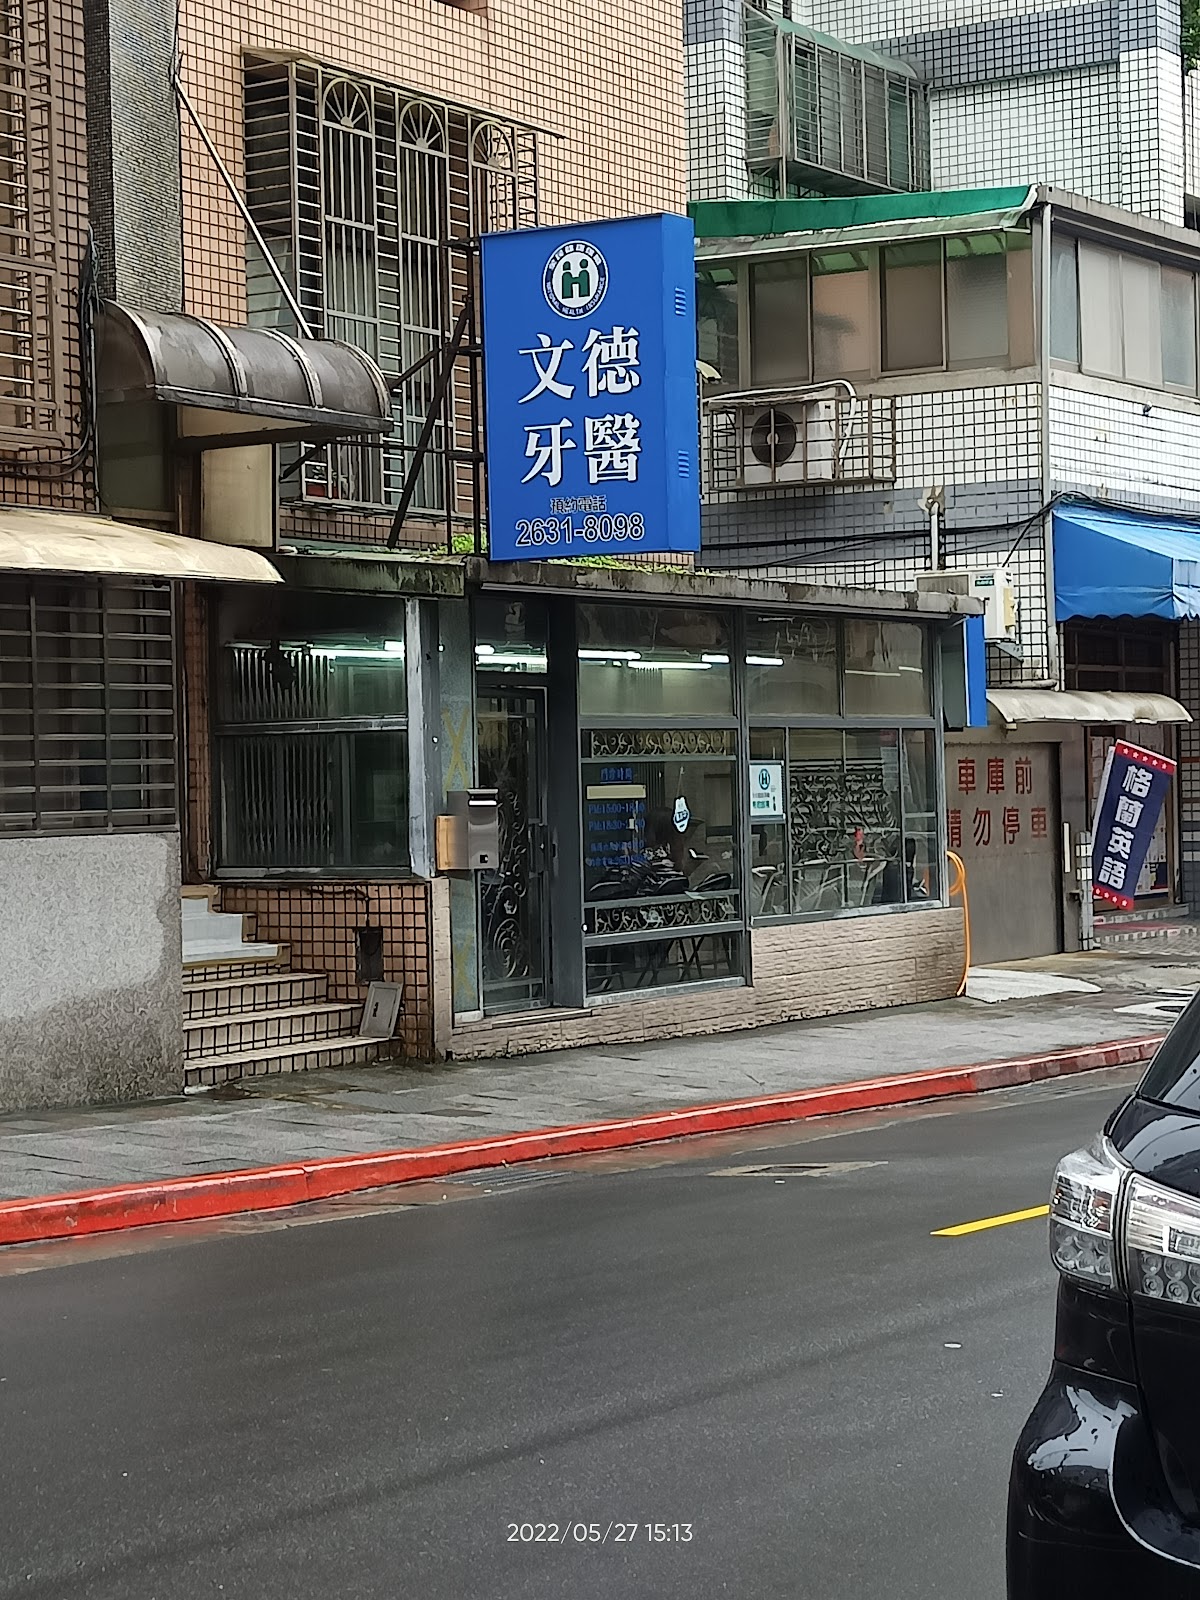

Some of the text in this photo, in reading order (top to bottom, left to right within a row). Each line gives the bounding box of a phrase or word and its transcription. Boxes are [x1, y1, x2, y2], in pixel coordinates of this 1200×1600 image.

[518, 326, 640, 404] 文德
[521, 412, 642, 487] 牙醫
[551, 494, 607, 515] 預約電話
[515, 512, 645, 547] 2631-8098
[957, 756, 1033, 795] 車庫前
[946, 806, 1048, 848] 請勿停車
[1098, 764, 1153, 890] 格蘭英語
